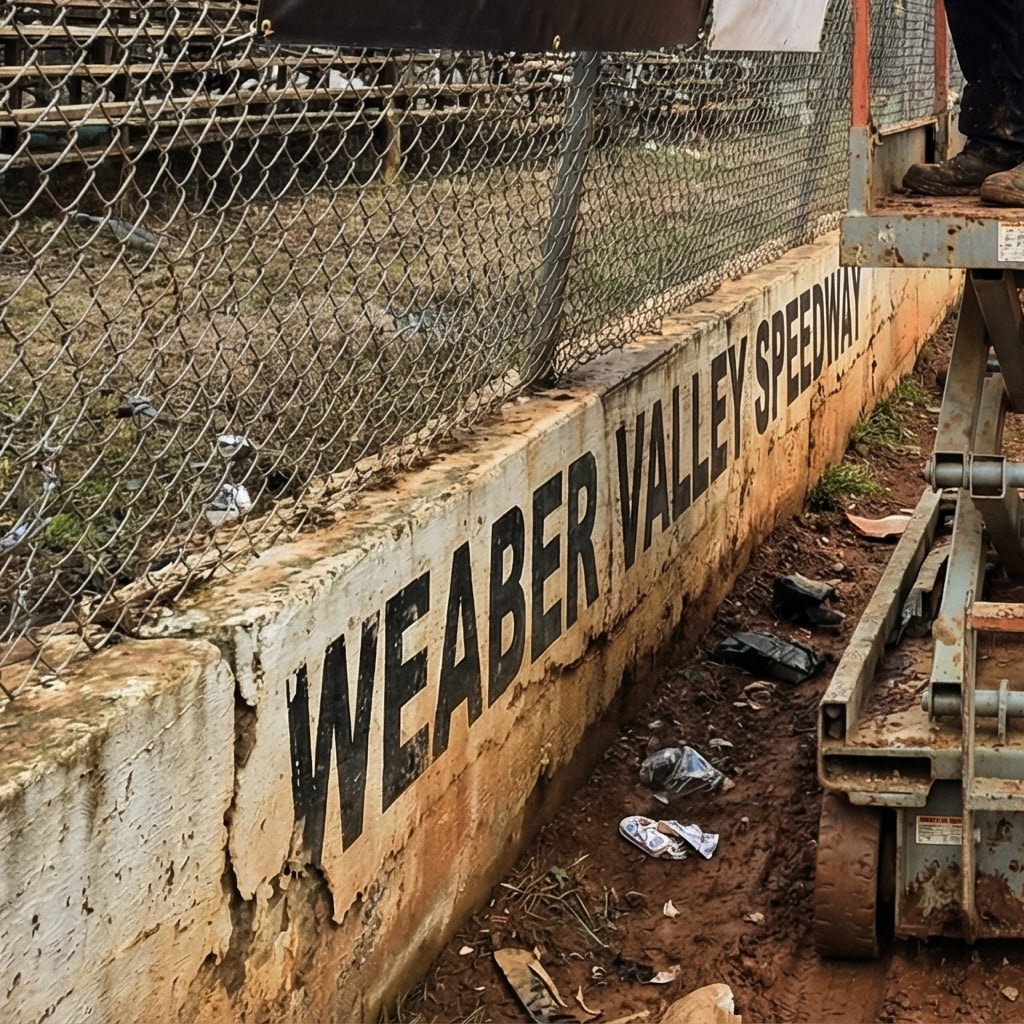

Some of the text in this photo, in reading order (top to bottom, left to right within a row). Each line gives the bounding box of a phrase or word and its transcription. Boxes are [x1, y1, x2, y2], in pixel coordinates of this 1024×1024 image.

[285, 266, 862, 865] WEABER VALLEY SPEEDWAY
